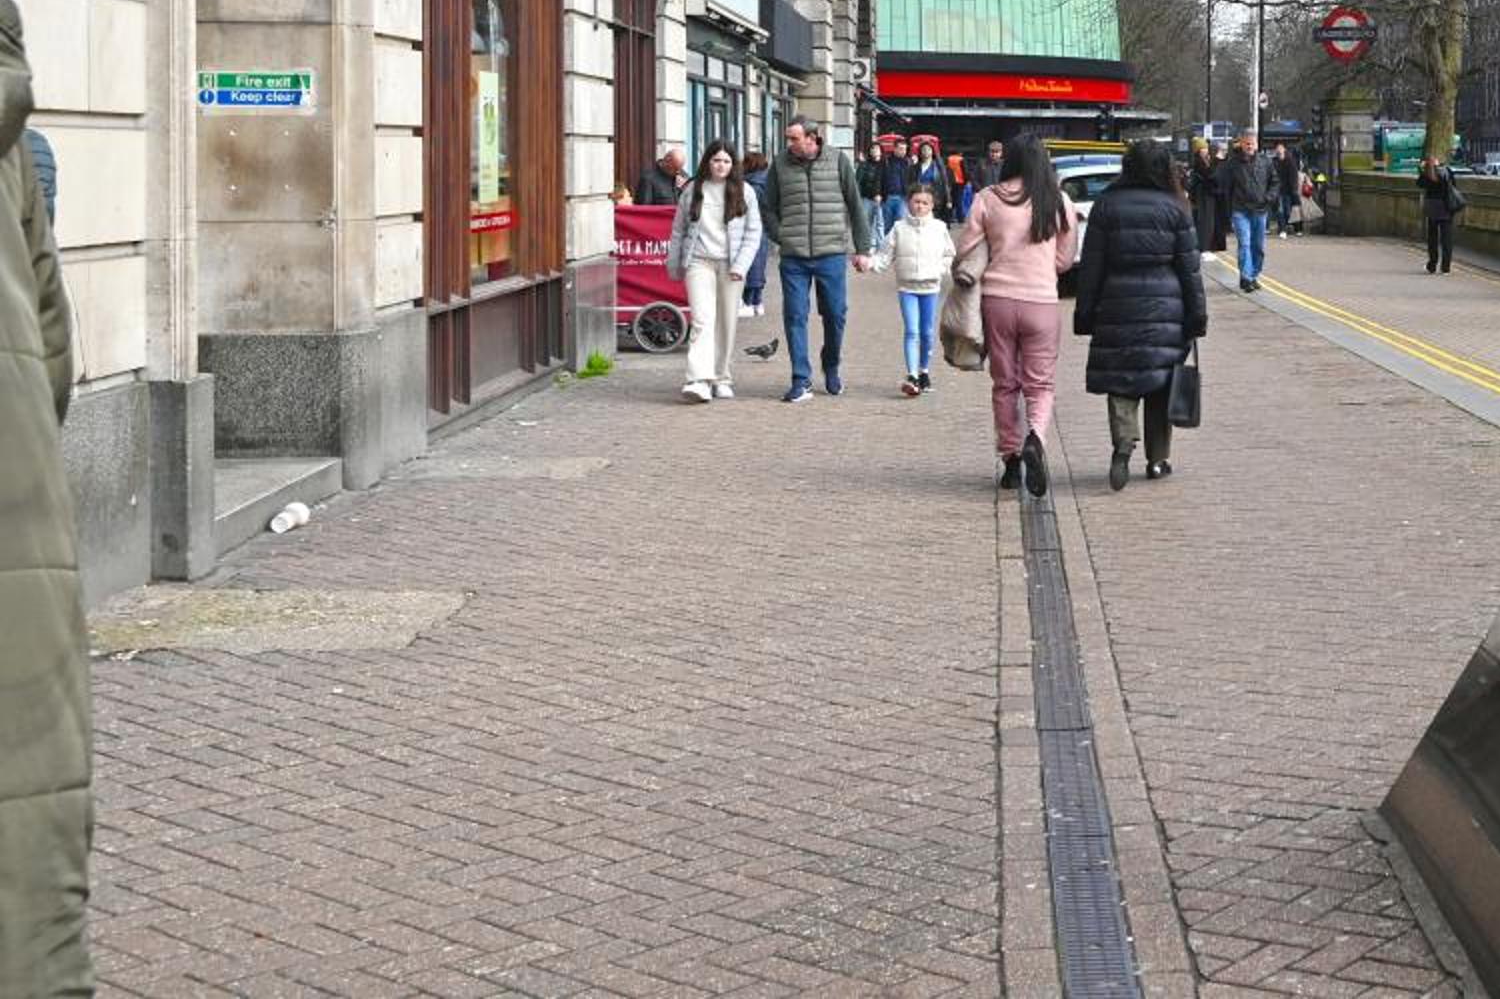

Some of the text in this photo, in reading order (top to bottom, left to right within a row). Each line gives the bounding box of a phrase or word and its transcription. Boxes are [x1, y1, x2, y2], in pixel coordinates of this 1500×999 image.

[235, 75, 292, 88] Fire exit
[231, 90, 296, 102] Keep clear
